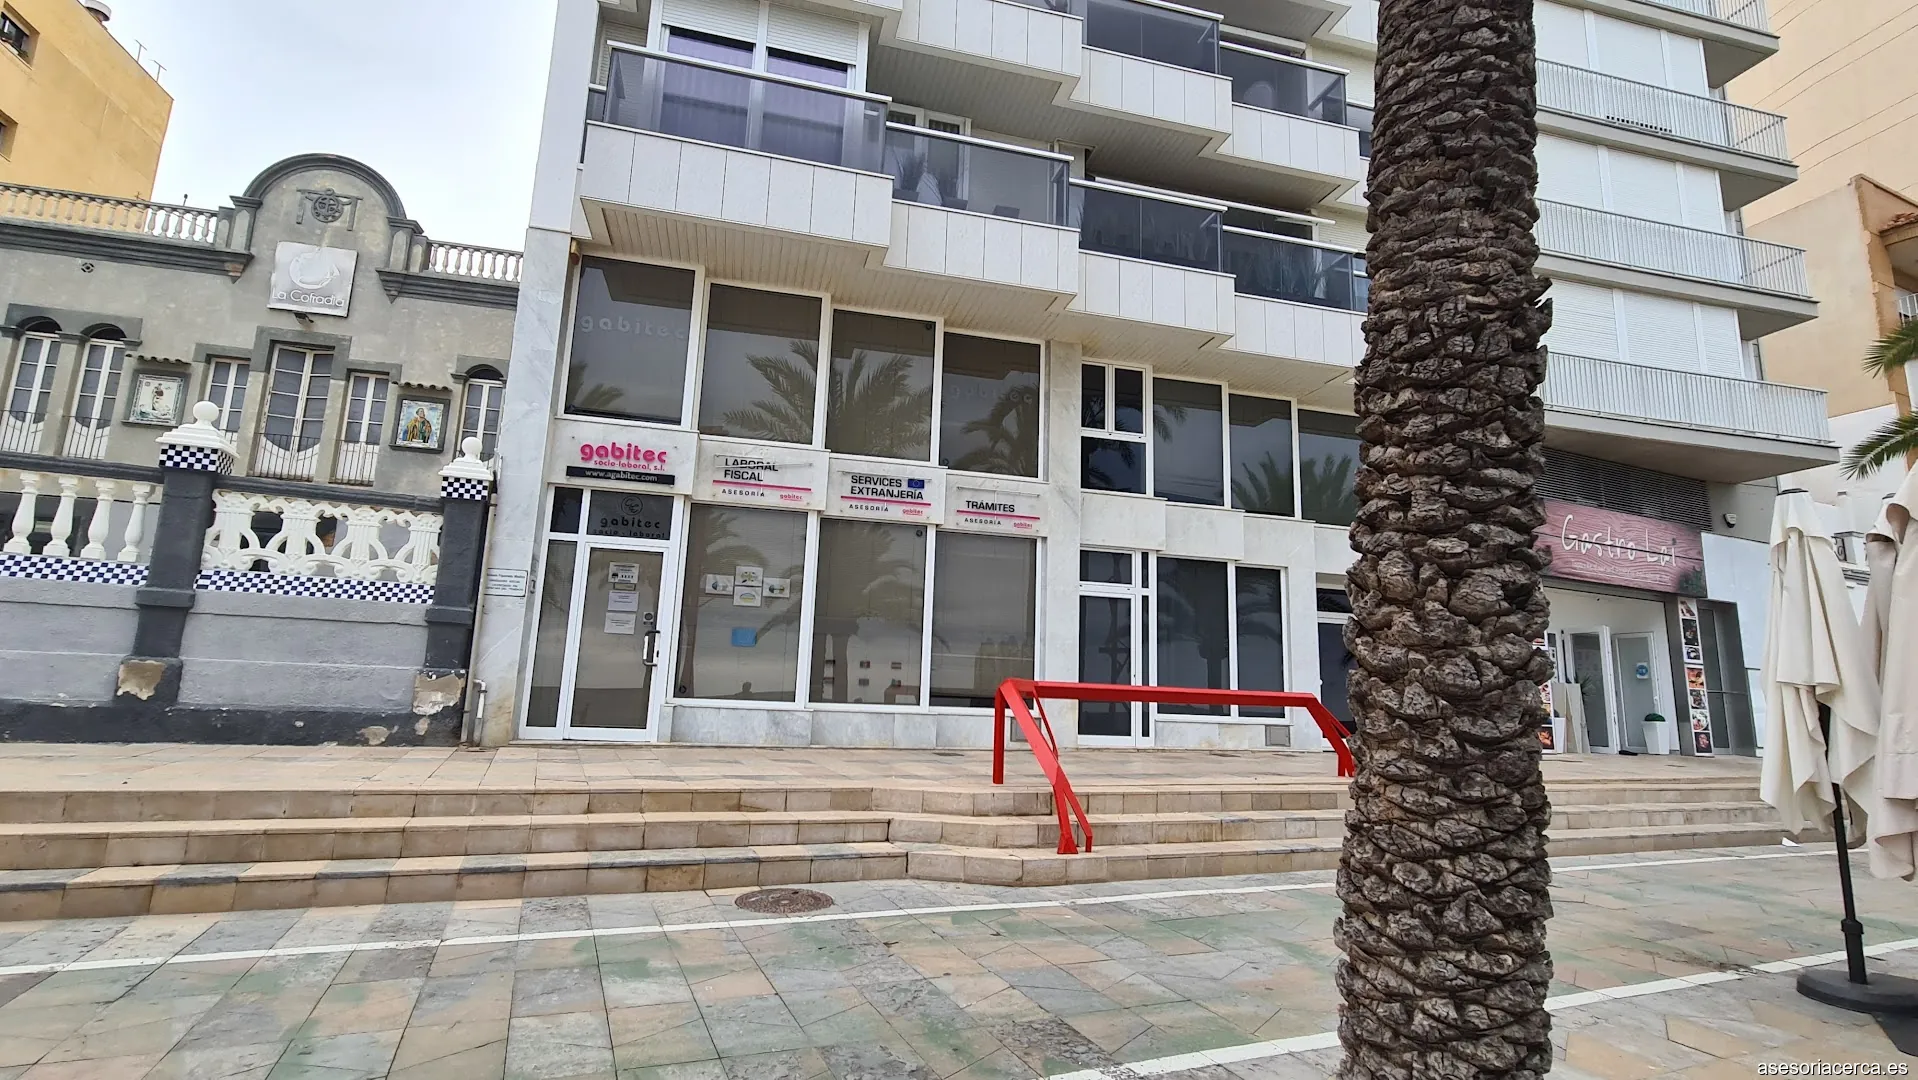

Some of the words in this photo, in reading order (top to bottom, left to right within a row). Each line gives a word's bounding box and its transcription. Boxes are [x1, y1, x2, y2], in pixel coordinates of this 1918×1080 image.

[272, 287, 287, 300] La
[580, 315, 685, 339] gabitec
[580, 442, 667, 463] gabitec
[725, 458, 779, 471] LABORAL
[585, 469, 658, 481] www.agabitec.com
[724, 469, 764, 481] FISCAL
[851, 475, 902, 488] SERVICES
[850, 486, 924, 500] EXTRANJERÍA
[965, 500, 1015, 513] TRÁMITES
[600, 516, 661, 529] gabitec
[1561, 514, 1637, 561] Gastro
